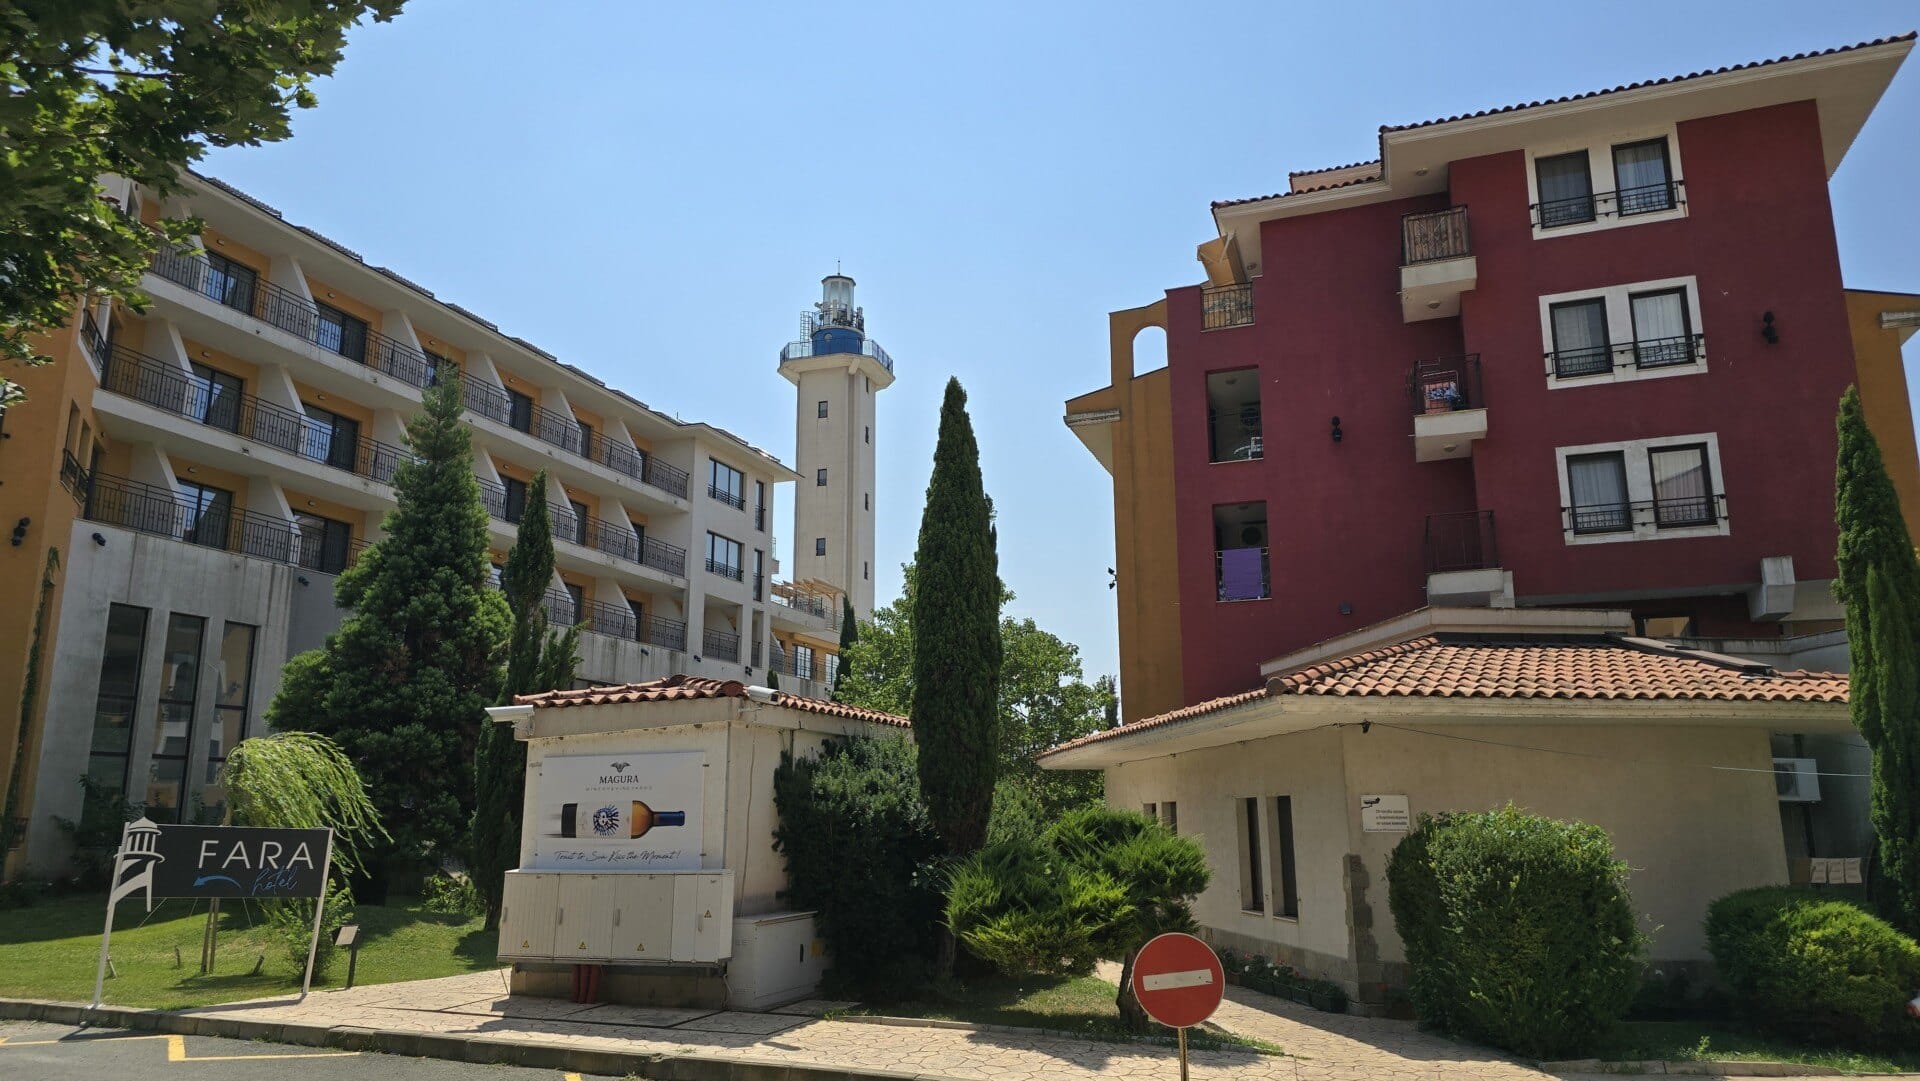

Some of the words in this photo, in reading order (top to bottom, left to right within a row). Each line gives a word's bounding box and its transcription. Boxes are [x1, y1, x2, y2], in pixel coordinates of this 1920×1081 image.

[599, 775, 639, 784] MAGURA
[198, 840, 314, 870] FARA
[252, 865, 299, 896] hotel
